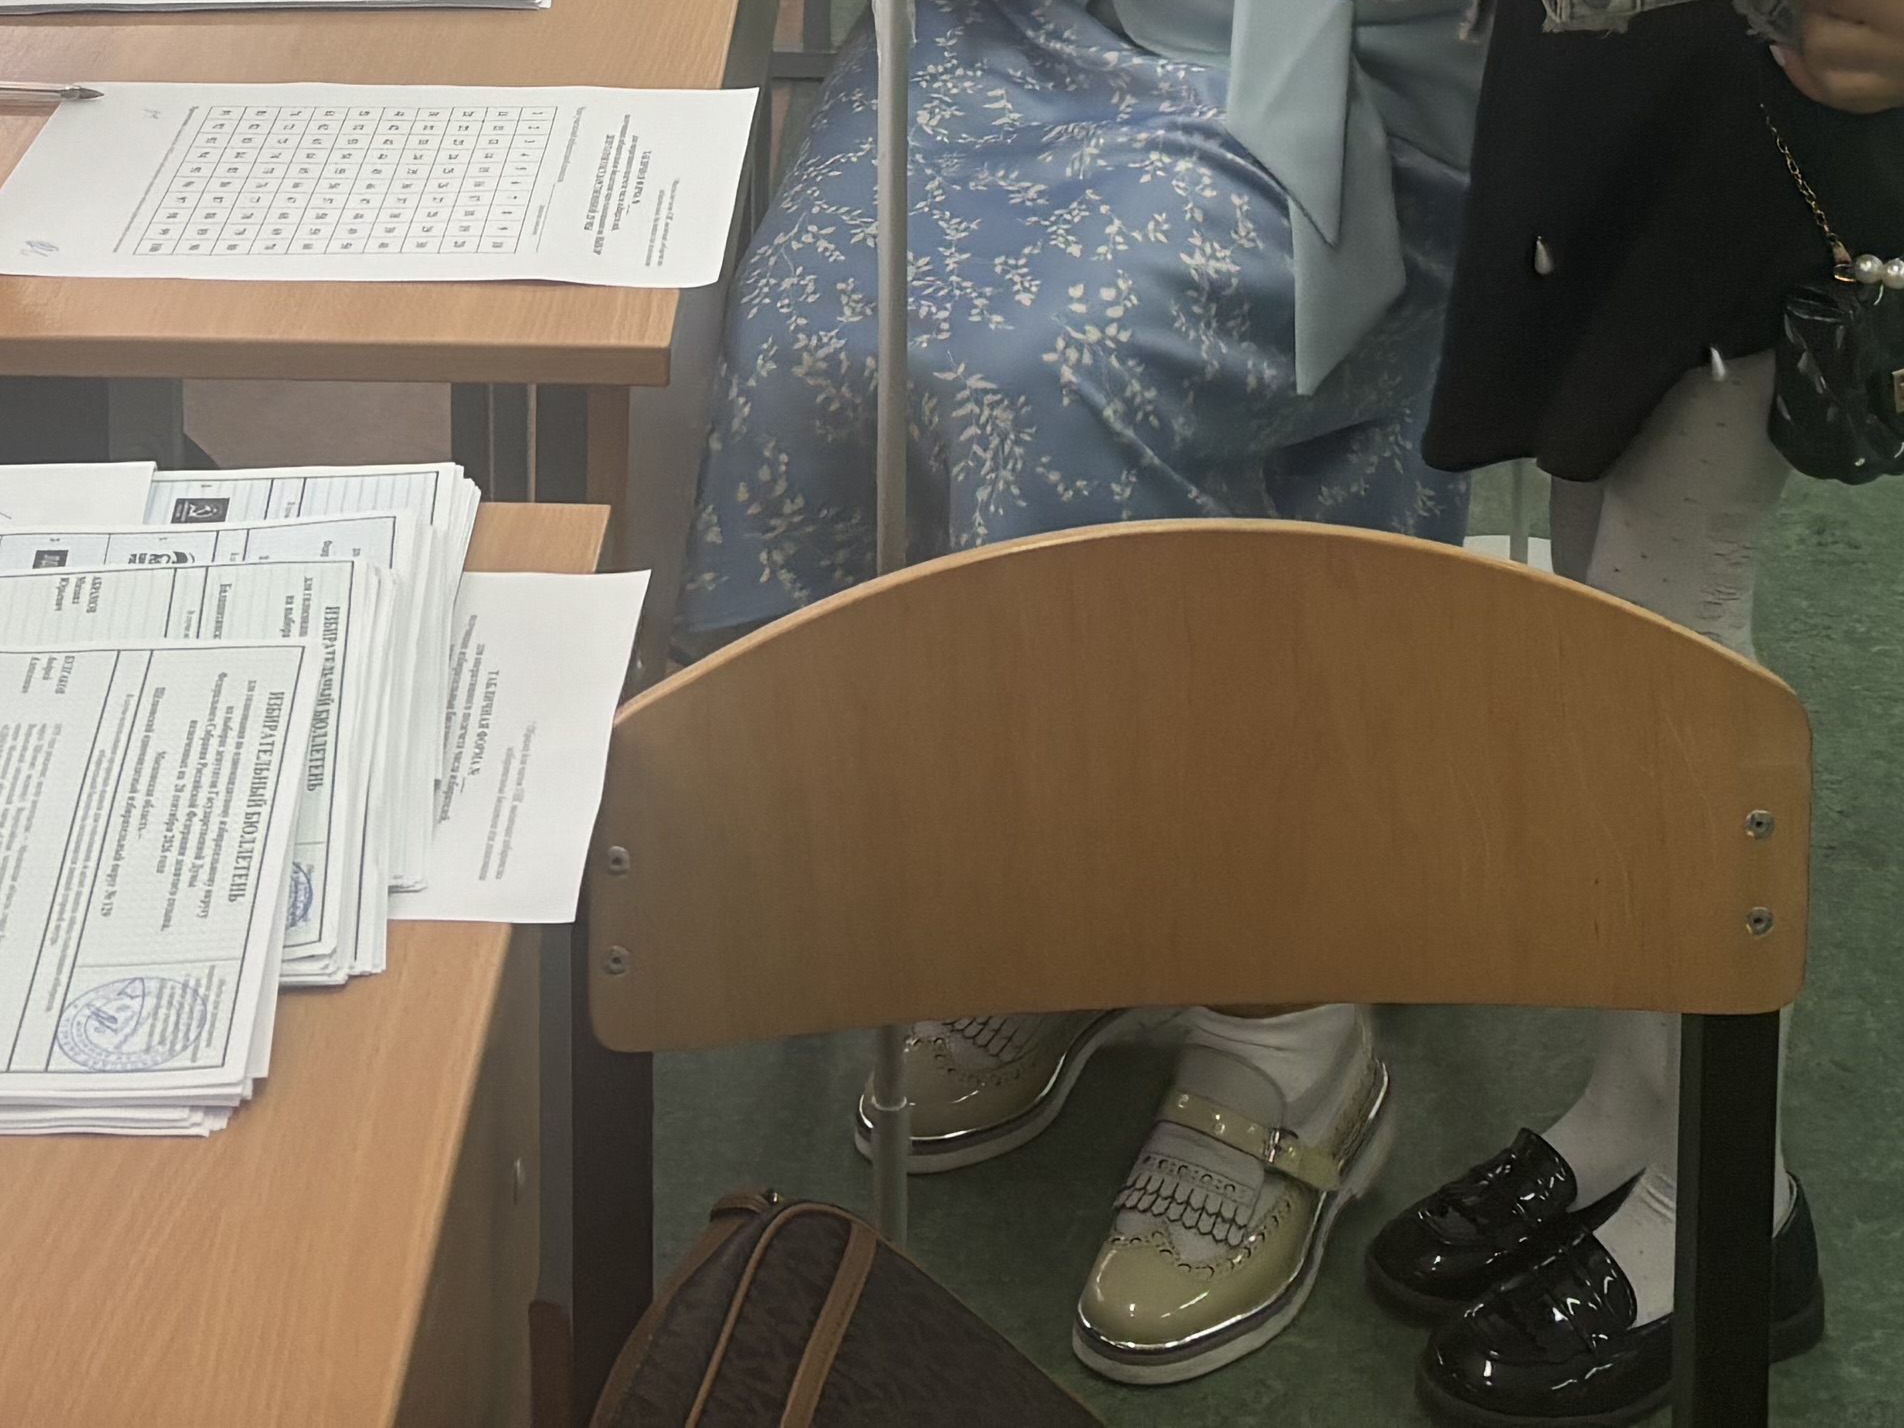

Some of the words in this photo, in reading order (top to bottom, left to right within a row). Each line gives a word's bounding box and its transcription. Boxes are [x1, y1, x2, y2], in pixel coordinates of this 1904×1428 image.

[245, 691, 288, 808] ИЗБИРАТЕЛЬНЫЙ
[305, 709, 330, 791] БЮЛЛЕТЕНЬ
[226, 811, 261, 902] БЮЛЛЕТЕНЬ
